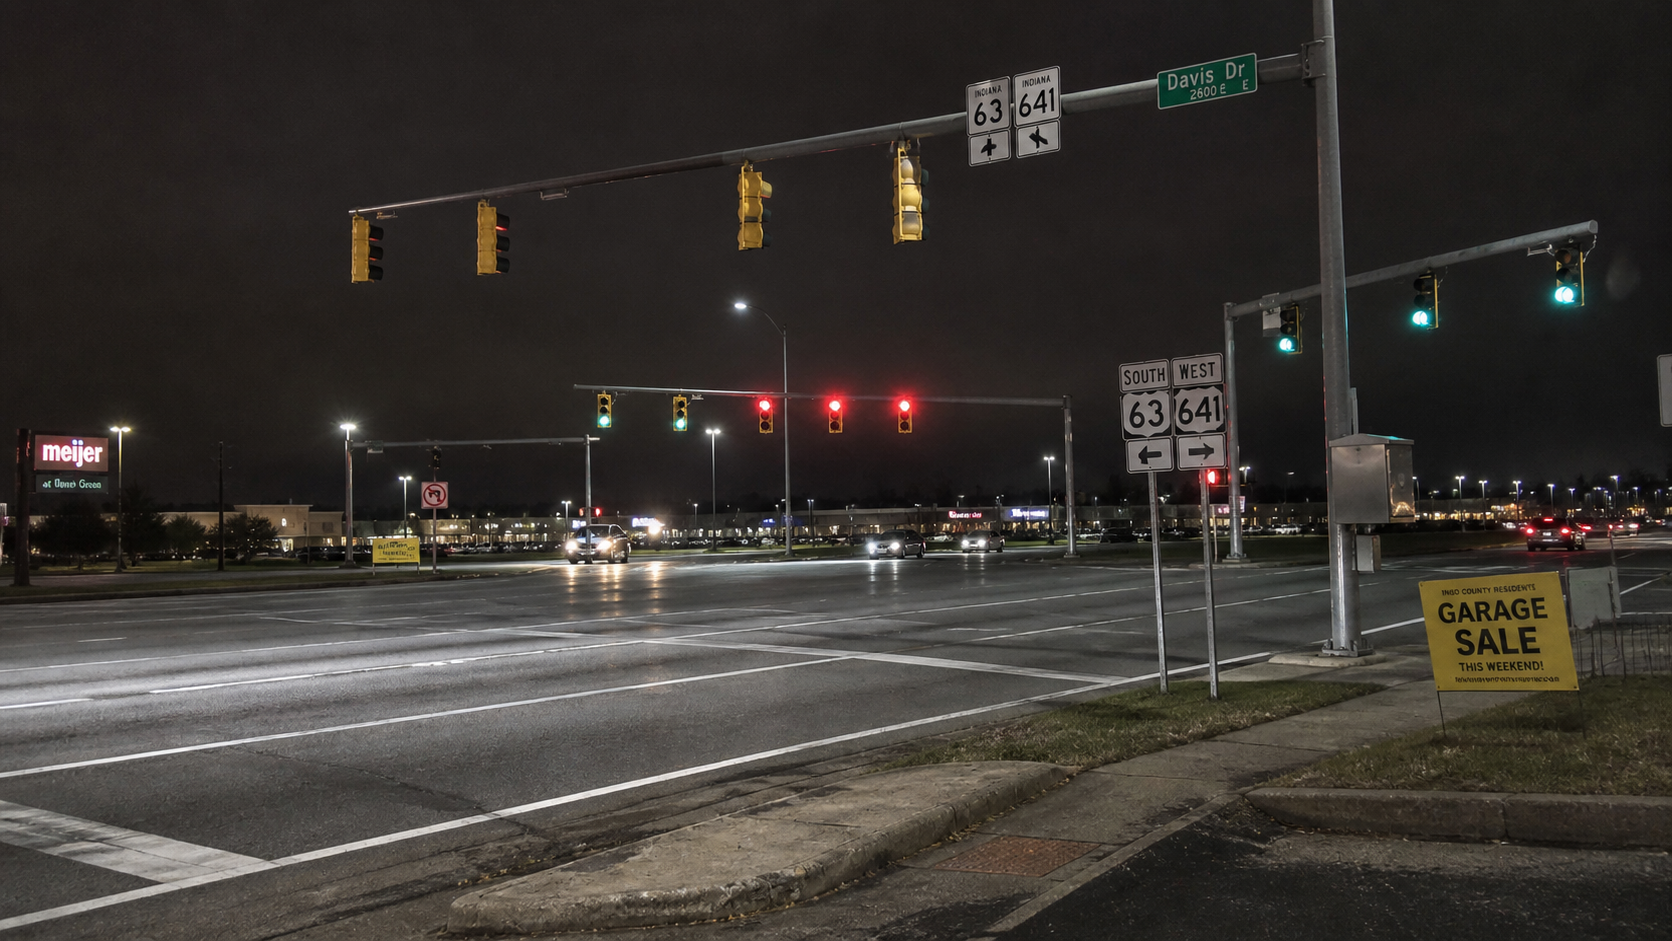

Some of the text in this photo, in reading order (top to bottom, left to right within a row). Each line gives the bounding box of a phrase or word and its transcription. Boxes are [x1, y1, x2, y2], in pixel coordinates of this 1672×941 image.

[1022, 75, 1051, 88] INDIANA
[1167, 62, 1245, 91] Davis Dr
[1190, 79, 1249, 100] 2600 E E
[974, 85, 1003, 98] INDIANA
[1018, 87, 1055, 118] 641
[973, 98, 1003, 126] 63
[1123, 367, 1166, 386] SOUTH
[1179, 361, 1216, 380] WEST
[1129, 399, 1164, 429] 63
[1178, 395, 1221, 425] 641
[42, 439, 103, 468] meijer
[1461, 586, 1492, 595] COUNTY
[1437, 597, 1548, 624] GARAGE
[1454, 626, 1541, 656] SALE
[1458, 661, 1545, 672] THIS WEEKEND!
